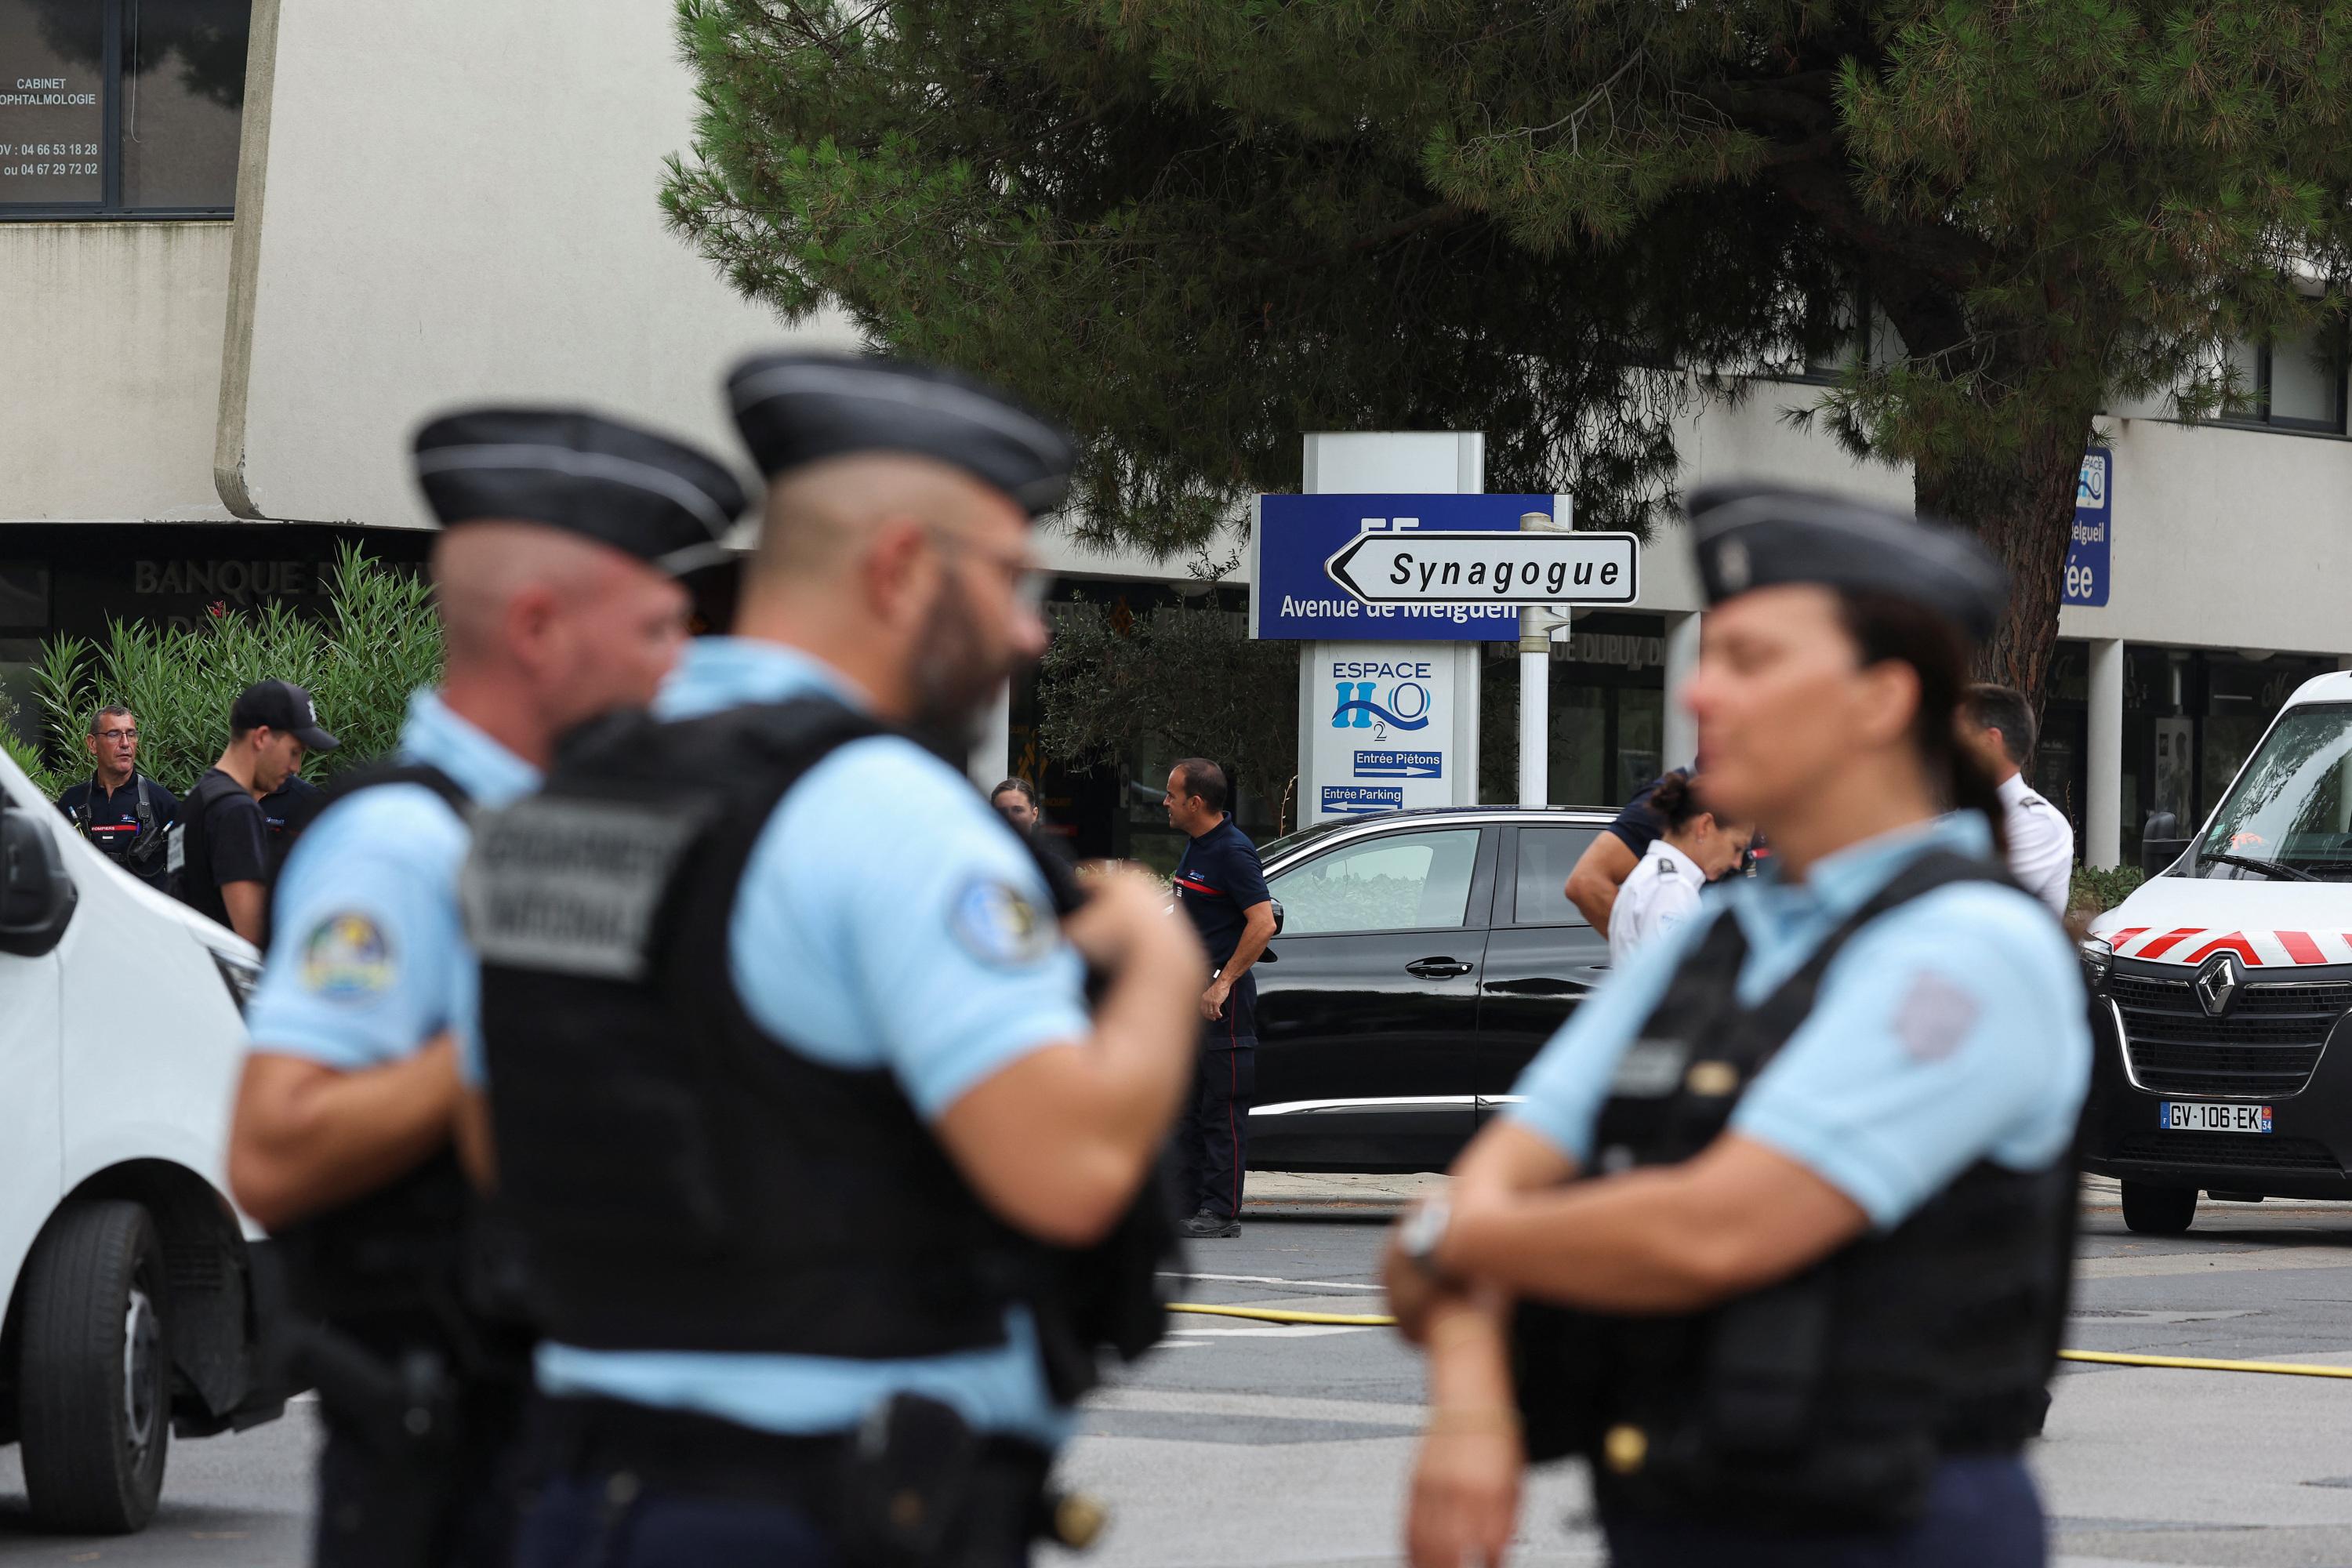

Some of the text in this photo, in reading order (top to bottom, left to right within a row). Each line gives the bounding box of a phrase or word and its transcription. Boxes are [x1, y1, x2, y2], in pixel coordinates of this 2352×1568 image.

[16, 78, 66, 89] CABINET
[21, 144, 34, 155] 04
[37, 144, 50, 155] 66
[53, 144, 65, 155] 53
[69, 144, 82, 155] 18
[85, 143, 97, 155] 28
[4, 163, 97, 176] ou 04 67 29 72 02
[2082, 459, 2103, 470] SPACE
[2071, 520, 2104, 545] elgueil
[1389, 553, 1619, 593] Synagogue
[136, 559, 301, 605] BANQUE
[1280, 595, 1359, 618] Avenue
[1333, 662, 1432, 678] ESPACE
[1356, 753, 1440, 764] Entrée Piétons
[1324, 789, 1401, 802] Entrée Parking
[2262, 1120, 2271, 1131] 34
